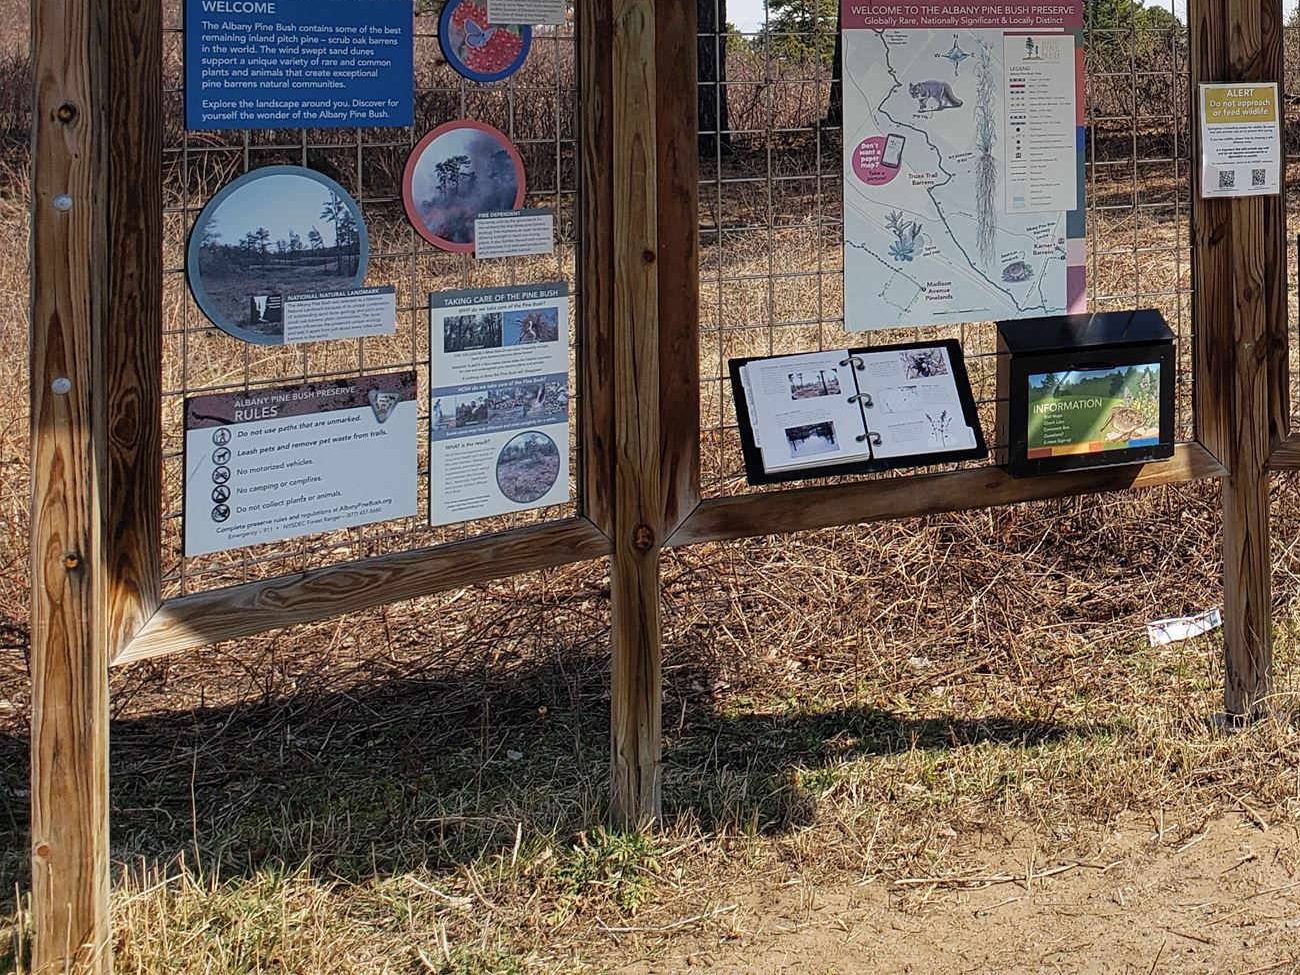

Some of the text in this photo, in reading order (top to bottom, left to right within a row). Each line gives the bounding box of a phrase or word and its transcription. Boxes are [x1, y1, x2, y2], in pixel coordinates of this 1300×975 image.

[202, 1, 276, 13] WELCOME
[851, 6, 1074, 15] WELCOME TO THE ALBANY PINE BUSH PRESERVE
[865, 17, 897, 26] Globally
[899, 17, 919, 25] Rare,
[921, 17, 959, 26] Nationally
[961, 16, 999, 25] Significant
[1010, 17, 1034, 25] Locally
[202, 21, 219, 29] The
[221, 22, 252, 32] Albany
[255, 23, 273, 31] Pine
[276, 23, 296, 31] Bush
[359, 25, 368, 33] of
[369, 26, 382, 34] the
[384, 26, 401, 34] best
[202, 34, 398, 45] remaining inland pitch pine scrub oak barrens
[202, 45, 210, 53] in
[213, 45, 227, 53] the
[260, 45, 276, 53] The
[279, 46, 299, 54] wind
[301, 48, 326, 56] swept
[329, 47, 348, 55] sand
[202, 58, 237, 66] support
[248, 57, 277, 66] unique
[280, 58, 308, 67] variety
[311, 57, 320, 66] of
[340, 58, 355, 66] and
[202, 68, 229, 78] plants
[232, 68, 248, 76] and
[251, 68, 283, 76] animals
[285, 69, 302, 77] that
[333, 69, 378, 78] exceptional
[202, 79, 346, 90] pine barrens natural communities.
[1226, 89, 1254, 97] ALERT
[202, 99, 399, 110] Explore the landscape around you. Discover for
[1238, 99, 1270, 107] approach
[202, 110, 390, 122] yourself the wonder of the Albany Pine Bush.
[444, 297, 472, 305] TAKING
[474, 295, 493, 303] CARE
[522, 291, 538, 299] PINE
[539, 290, 558, 298] BUSH
[234, 386, 355, 408] ALBANY PINE BUSH PRESERVE
[1033, 399, 1102, 414] INFORMATION
[234, 406, 278, 421] RULES
[238, 430, 248, 438] Do
[278, 424, 297, 435] paths
[300, 421, 313, 430] that
[327, 415, 362, 425] unmarked.
[237, 429, 388, 457] Leash pets and remove pet waste from trails.
[249, 463, 284, 473] motorized
[286, 458, 314, 468] vehicles.
[249, 482, 278, 493] camping
[289, 475, 323, 486] campfires.
[250, 503, 260, 511] not
[262, 500, 284, 509] collect
[286, 495, 306, 505] plants
[316, 490, 342, 500] animals.
